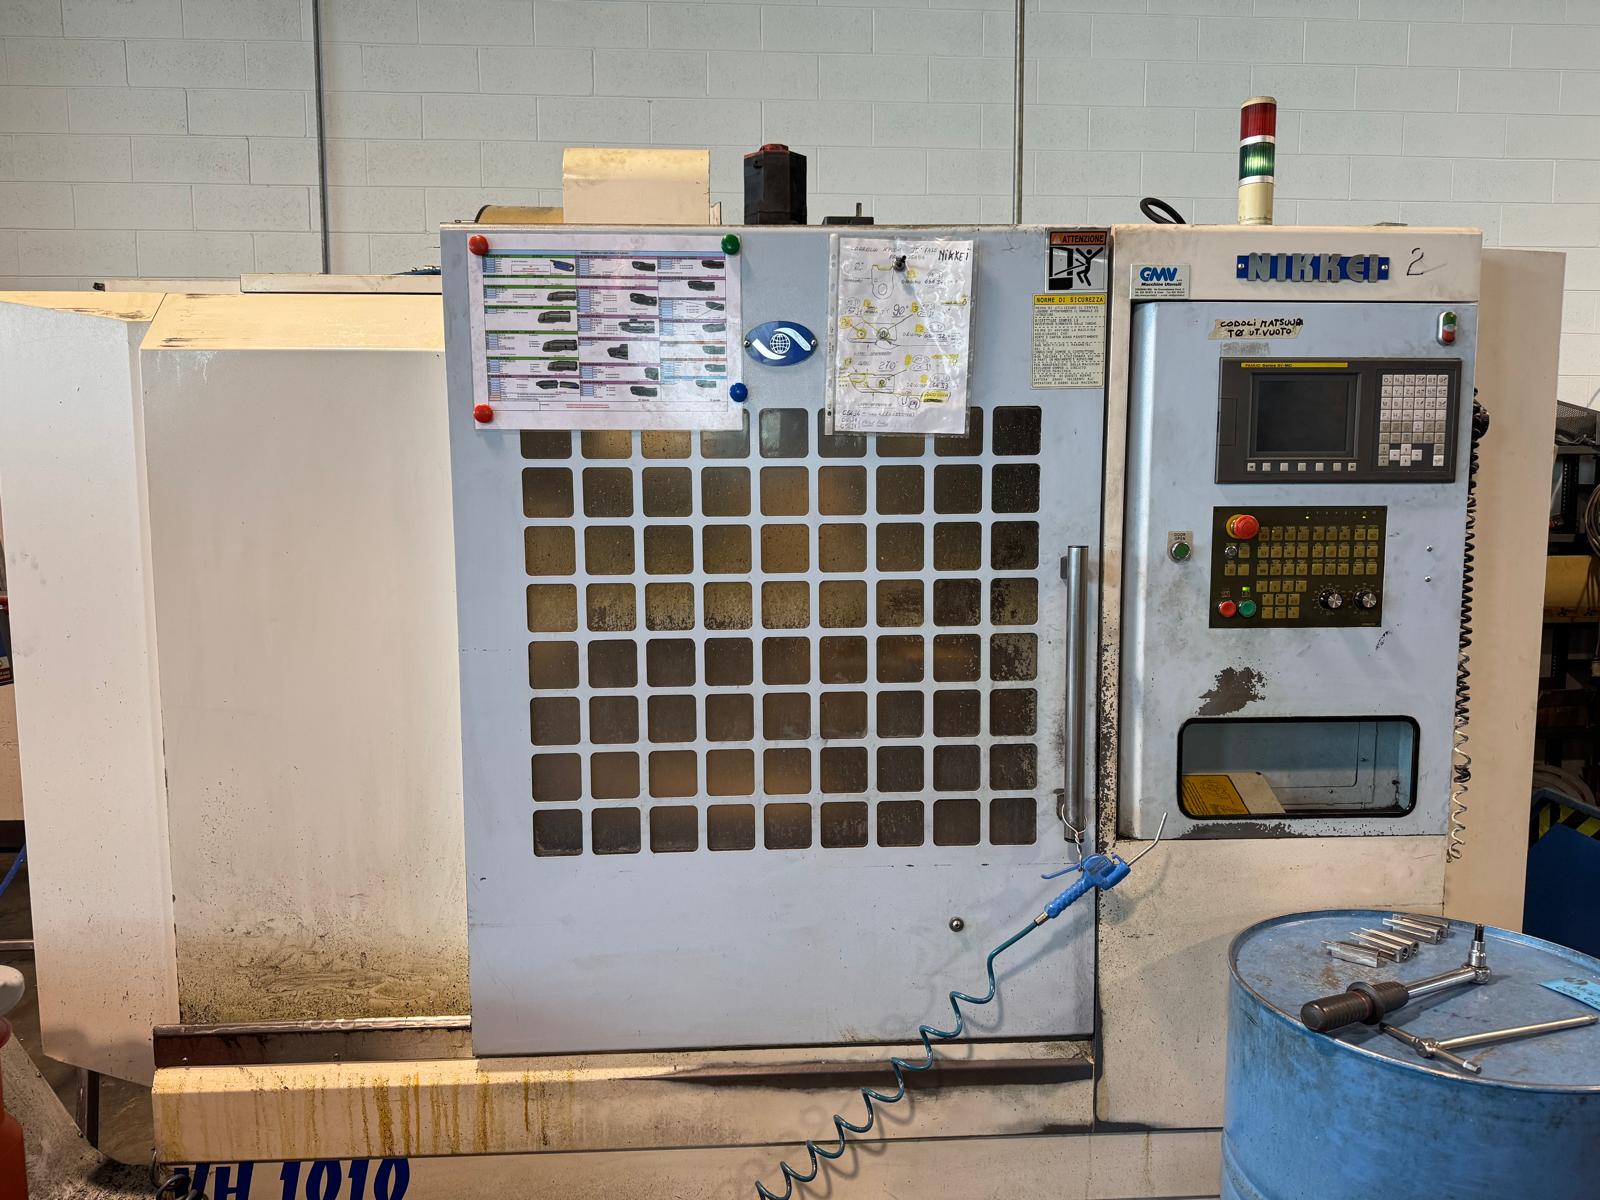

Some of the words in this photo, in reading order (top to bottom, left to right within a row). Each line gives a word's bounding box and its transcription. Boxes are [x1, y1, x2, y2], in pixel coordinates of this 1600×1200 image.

[1062, 234, 1104, 244] ATTENZIONE
[1247, 252, 1380, 283] NIKKEI
[1406, 247, 1425, 277] 2
[280, 1157, 410, 1200] 1010
